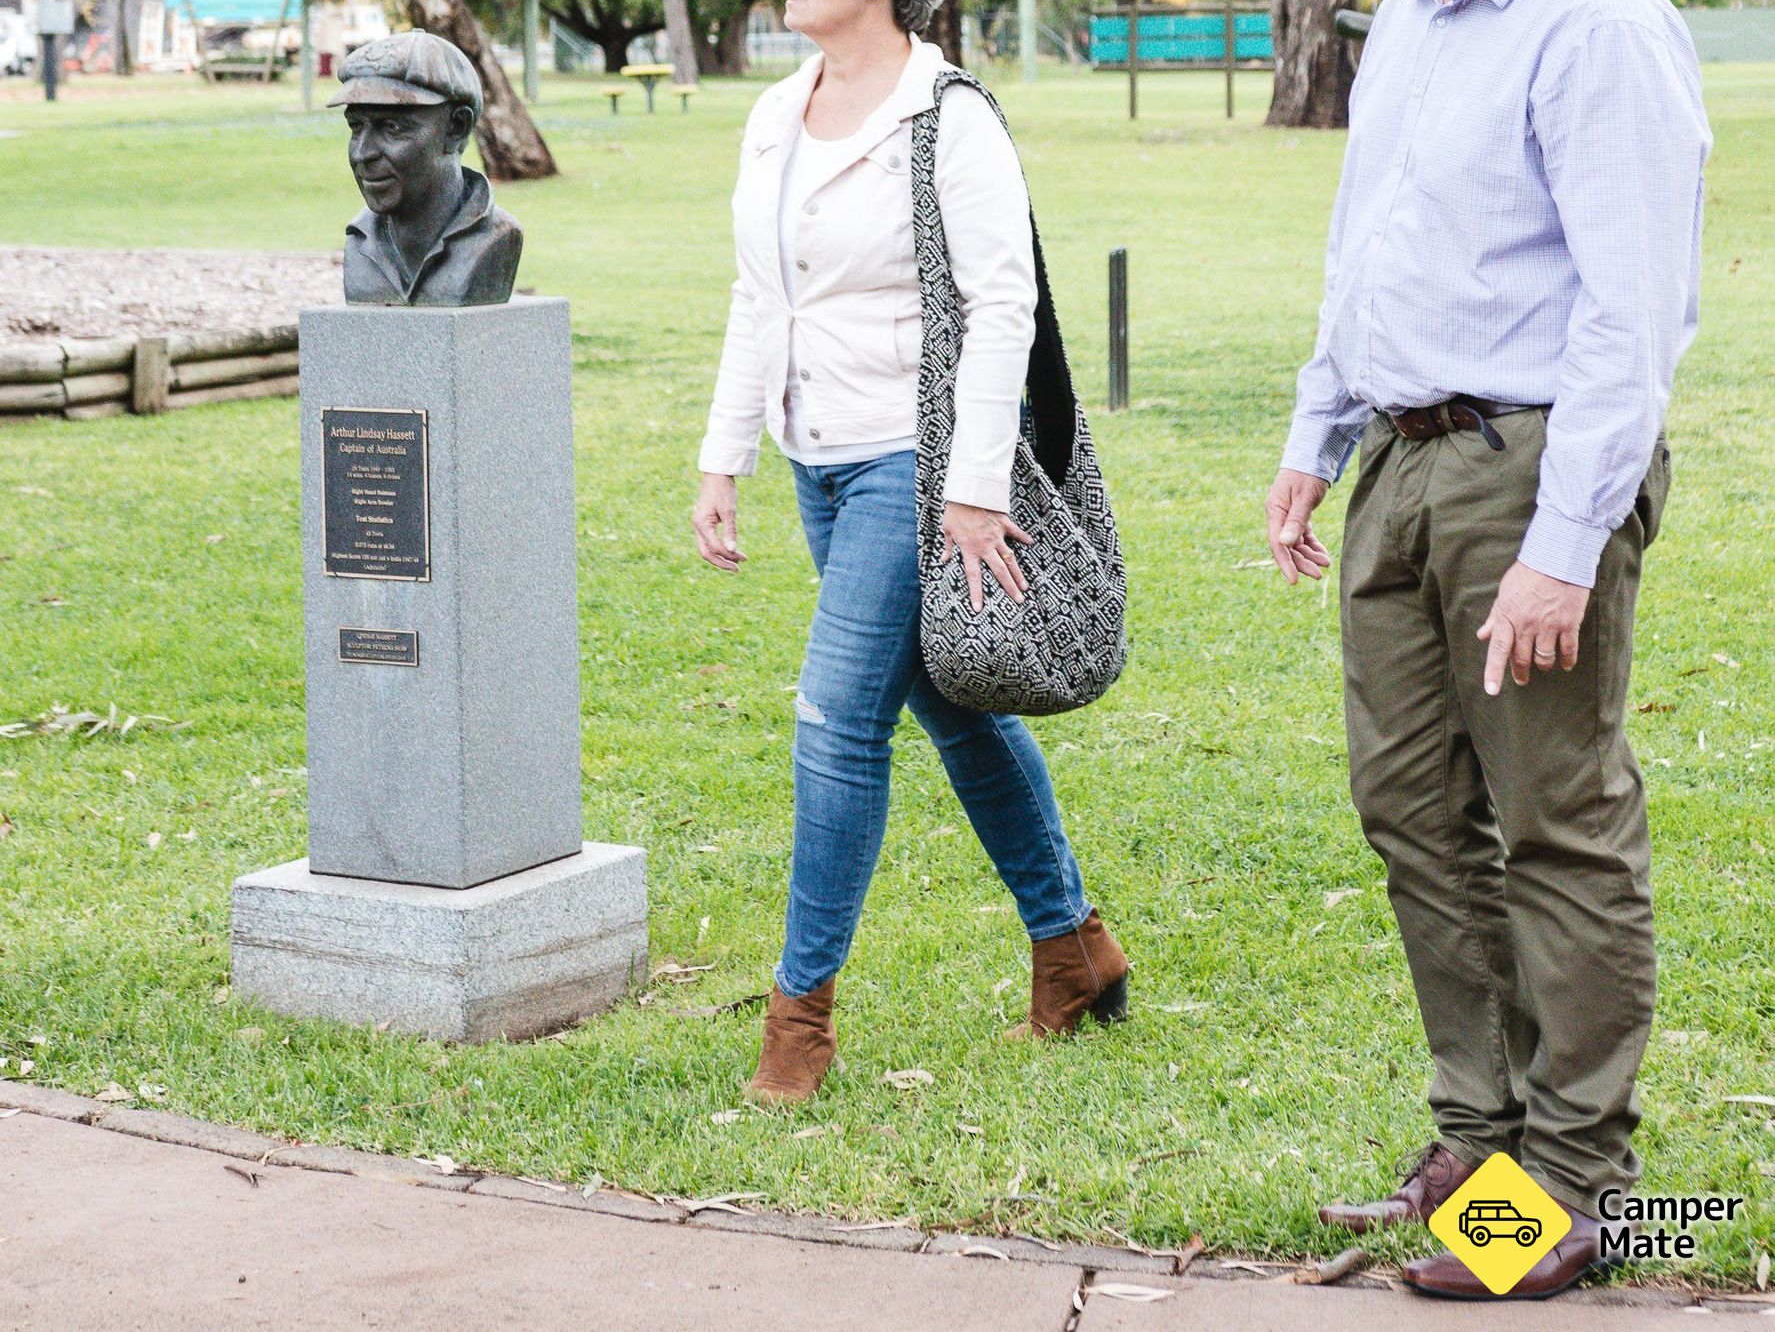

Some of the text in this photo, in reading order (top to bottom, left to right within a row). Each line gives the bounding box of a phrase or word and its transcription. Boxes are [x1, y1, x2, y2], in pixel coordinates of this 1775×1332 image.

[331, 427, 415, 441] Arthur Lindsay Hassett
[340, 443, 406, 455] Captain of Australia
